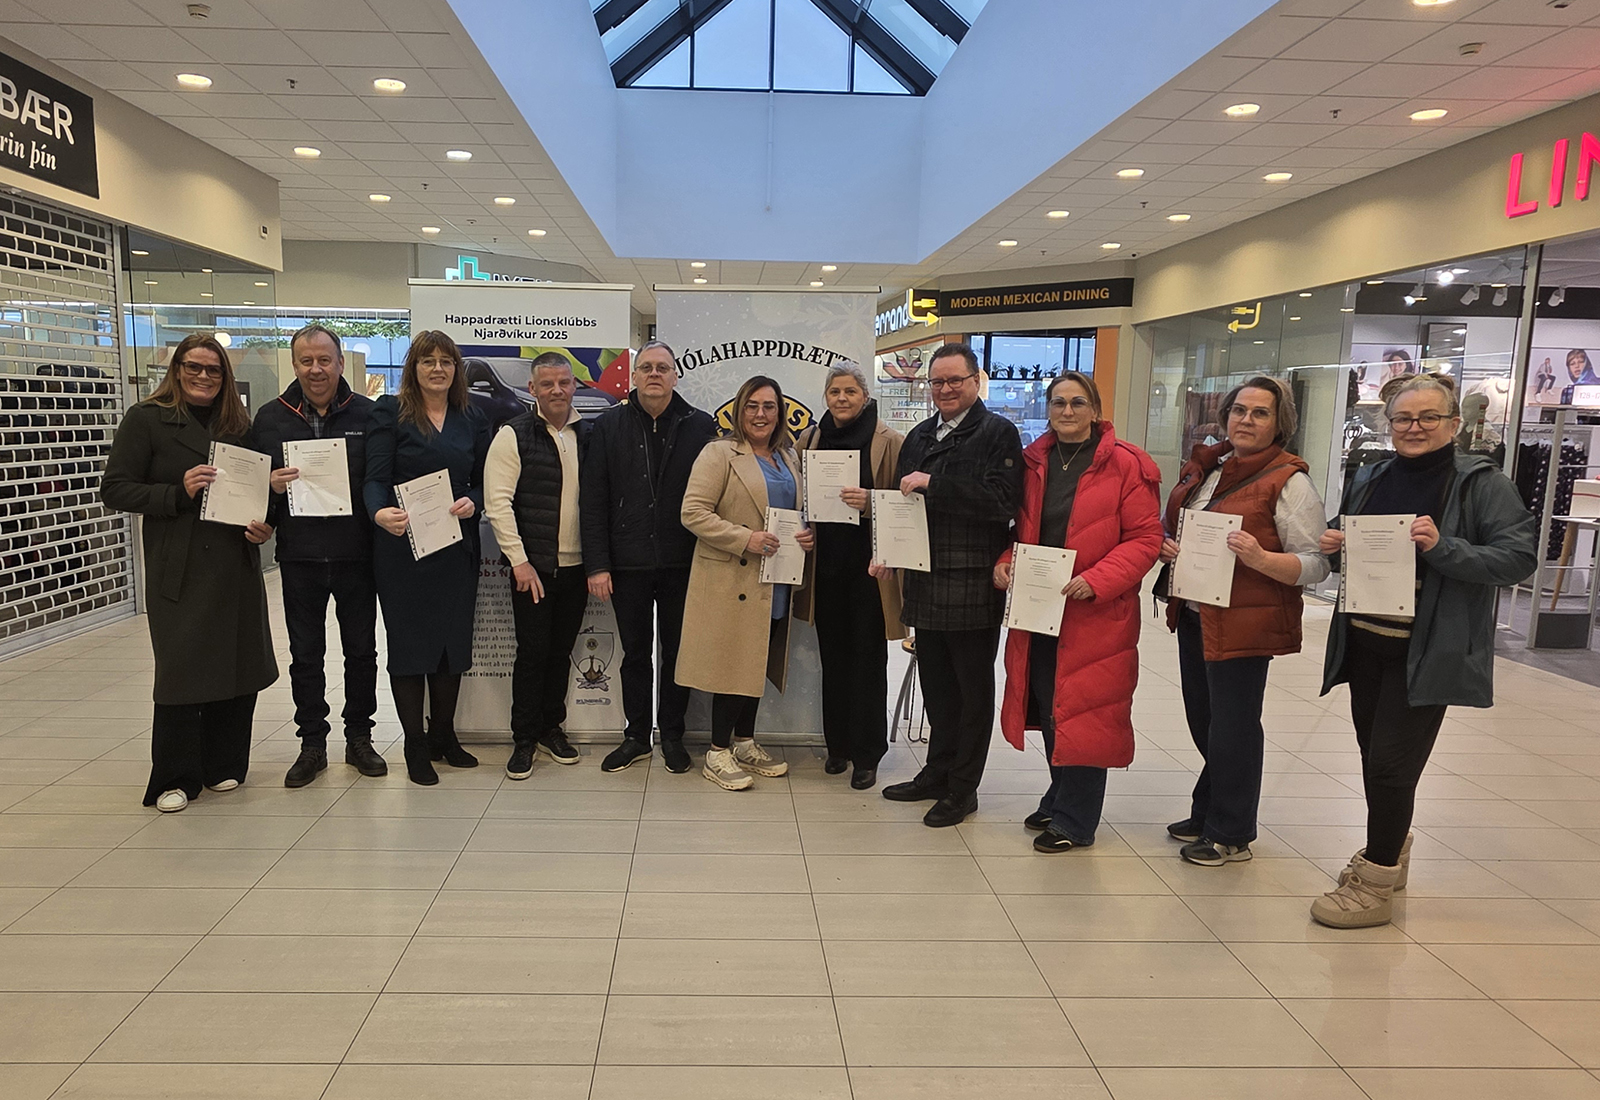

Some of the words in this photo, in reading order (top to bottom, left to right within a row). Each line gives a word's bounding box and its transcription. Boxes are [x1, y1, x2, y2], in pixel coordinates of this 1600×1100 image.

[29, 140, 57, 170] þín
[950, 296, 1000, 309] MODERN
[1003, 291, 1060, 306] MEXICAN
[1063, 287, 1110, 302] DINING
[445, 314, 522, 326] Happadrætti
[525, 316, 597, 327] Lionsklúbbs
[474, 328, 537, 340] Njarðvíkur
[540, 330, 568, 340] 2025
[674, 339, 859, 379] JÓLAHAPPDRÆT
